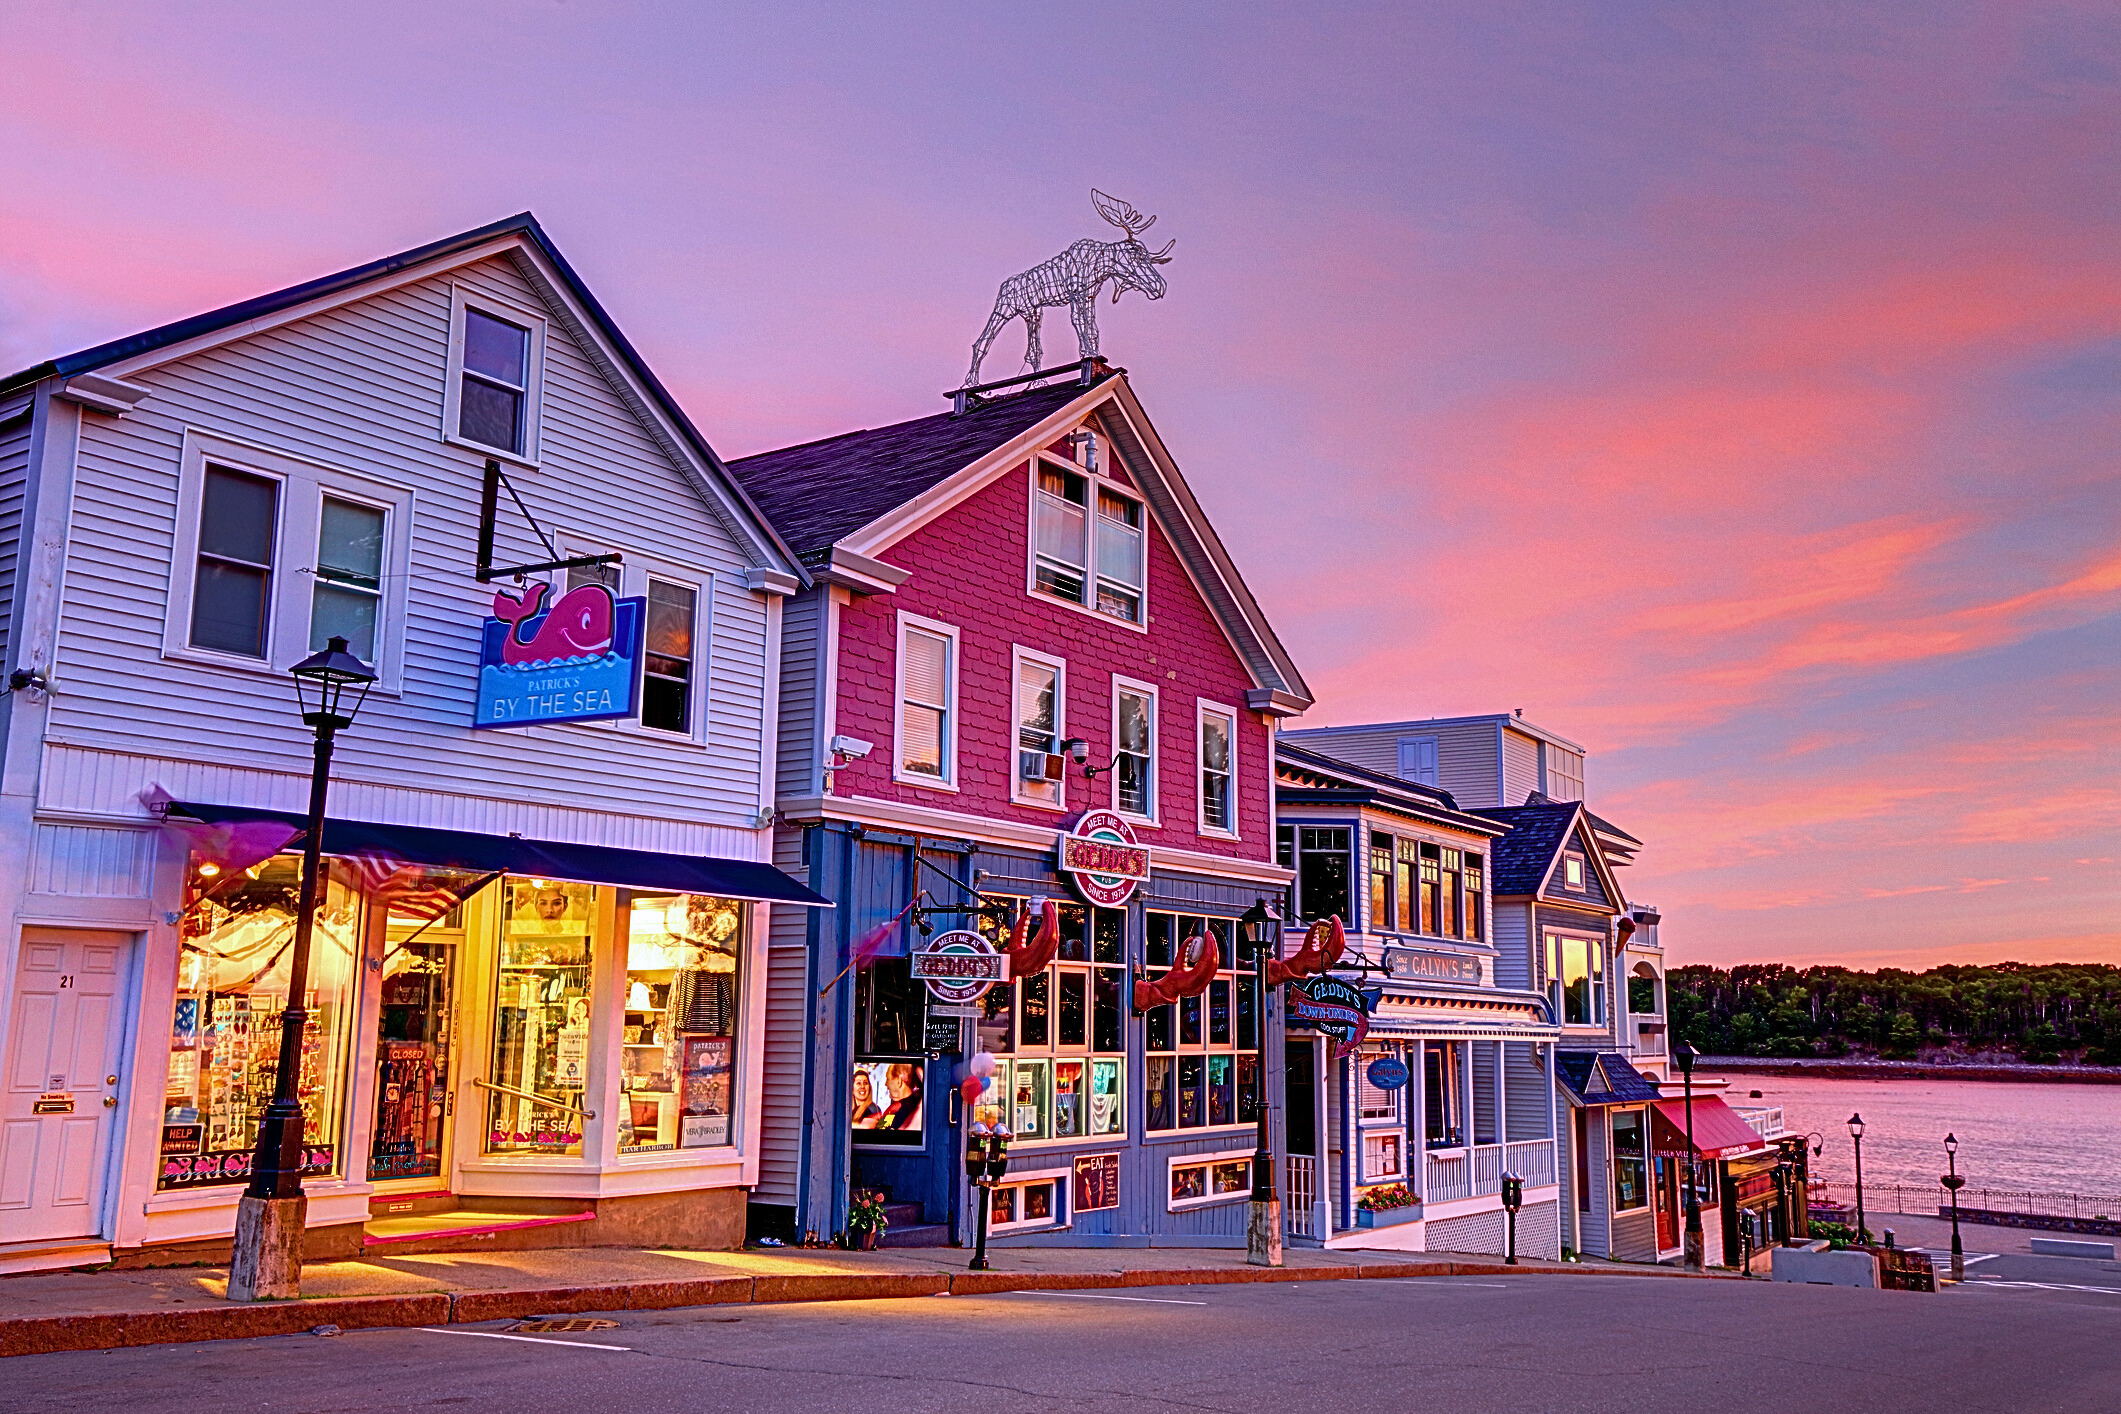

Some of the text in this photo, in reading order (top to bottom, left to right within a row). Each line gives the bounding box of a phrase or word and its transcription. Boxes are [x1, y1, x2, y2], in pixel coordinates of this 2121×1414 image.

[528, 676, 580, 692] PATRICK'S
[493, 688, 613, 719] BY THE SEA
[1087, 815, 1129, 836] MEET ME AT
[1075, 844, 1143, 876] GEDDY'S
[1101, 876, 1112, 884] PUB
[1087, 883, 1125, 901] SINCE 1974
[938, 935, 981, 948] MEET ME AT
[922, 957, 992, 977] GEDDY'S
[1395, 954, 1408, 964] Since
[1412, 956, 1459, 978] GALYN'S
[60, 975, 74, 988] 21
[938, 985, 977, 998] SINCE 1974
[1314, 982, 1361, 1009] GEDDY'S
[1298, 1001, 1359, 1025] DOWN-UNDER
[1320, 1022, 1332, 1033] COOL
[693, 1042, 726, 1053] PATRICK'S
[392, 1050, 424, 1059] CLOSED
[1371, 1067, 1403, 1078] Galyn's
[495, 1120, 513, 1131] BY
[550, 1120, 577, 1132] SEA
[686, 1126, 727, 1136] VERA BRADLEY
[169, 1128, 193, 1139] HELP
[162, 1140, 198, 1151] WANTED
[622, 1144, 673, 1154] BAR HARBOR
[1653, 1149, 1675, 1158] Little
[1675, 1150, 1701, 1160] Villge
[1090, 1156, 1105, 1170] EAT
